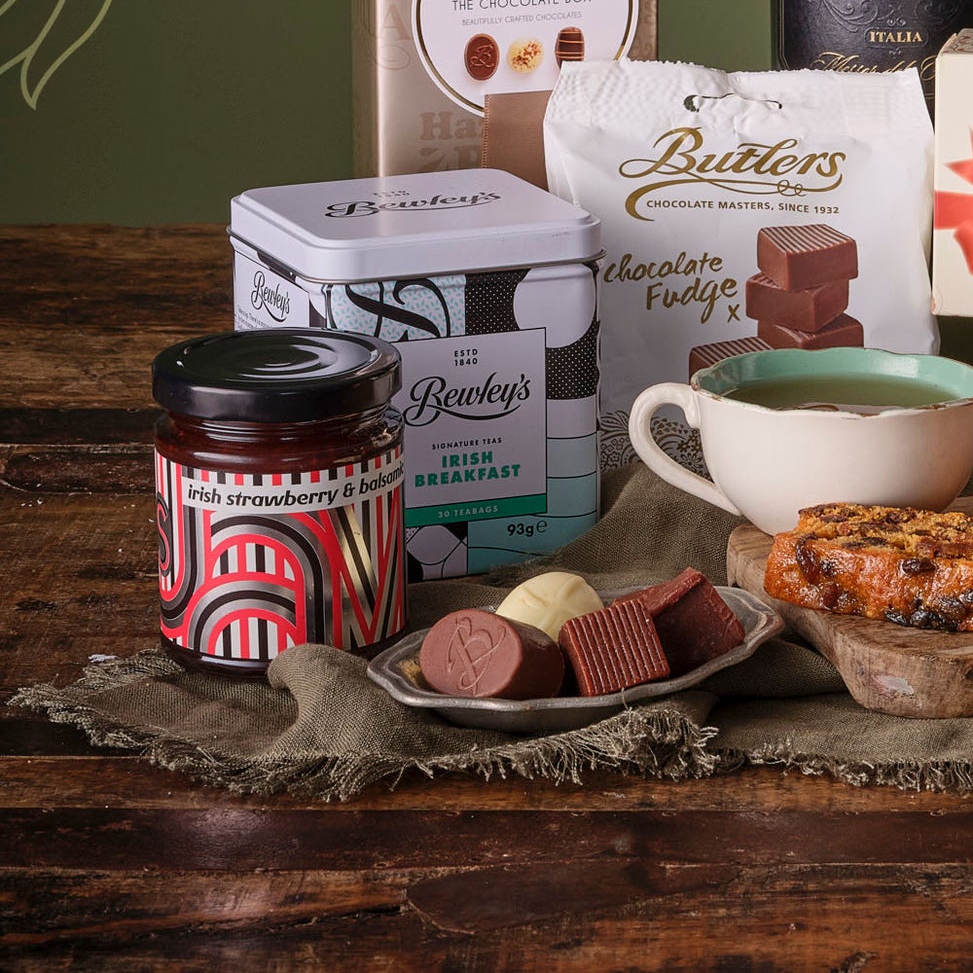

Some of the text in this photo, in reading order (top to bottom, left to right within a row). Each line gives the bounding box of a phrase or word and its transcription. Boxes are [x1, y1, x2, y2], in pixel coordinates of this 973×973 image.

[452, 0, 474, 11] THE
[462, 11, 582, 26] BEAUTIFULLY CRAFTED CHOCOLATES
[869, 31, 923, 43] ITALIA
[619, 127, 847, 194] Butlers
[324, 191, 501, 218] Bewley's
[646, 200, 840, 214] CHOCOLATE MASTERS, SINCE 1932
[603, 252, 723, 283] chocolate
[251, 270, 290, 322] Bewley's
[645, 277, 738, 323] Fudge
[454, 348, 479, 357] ESTD
[454, 358, 478, 367] 1840
[402, 371, 531, 427] Bewley's
[432, 437, 502, 451] SIGNATURE TEAS
[442, 451, 493, 468] IRISH
[415, 464, 521, 488] BREAKFAST
[188, 484, 222, 504] irish
[226, 488, 339, 507] strawberry
[343, 482, 355, 498] &
[438, 506, 499, 519] 30 TEABAGS
